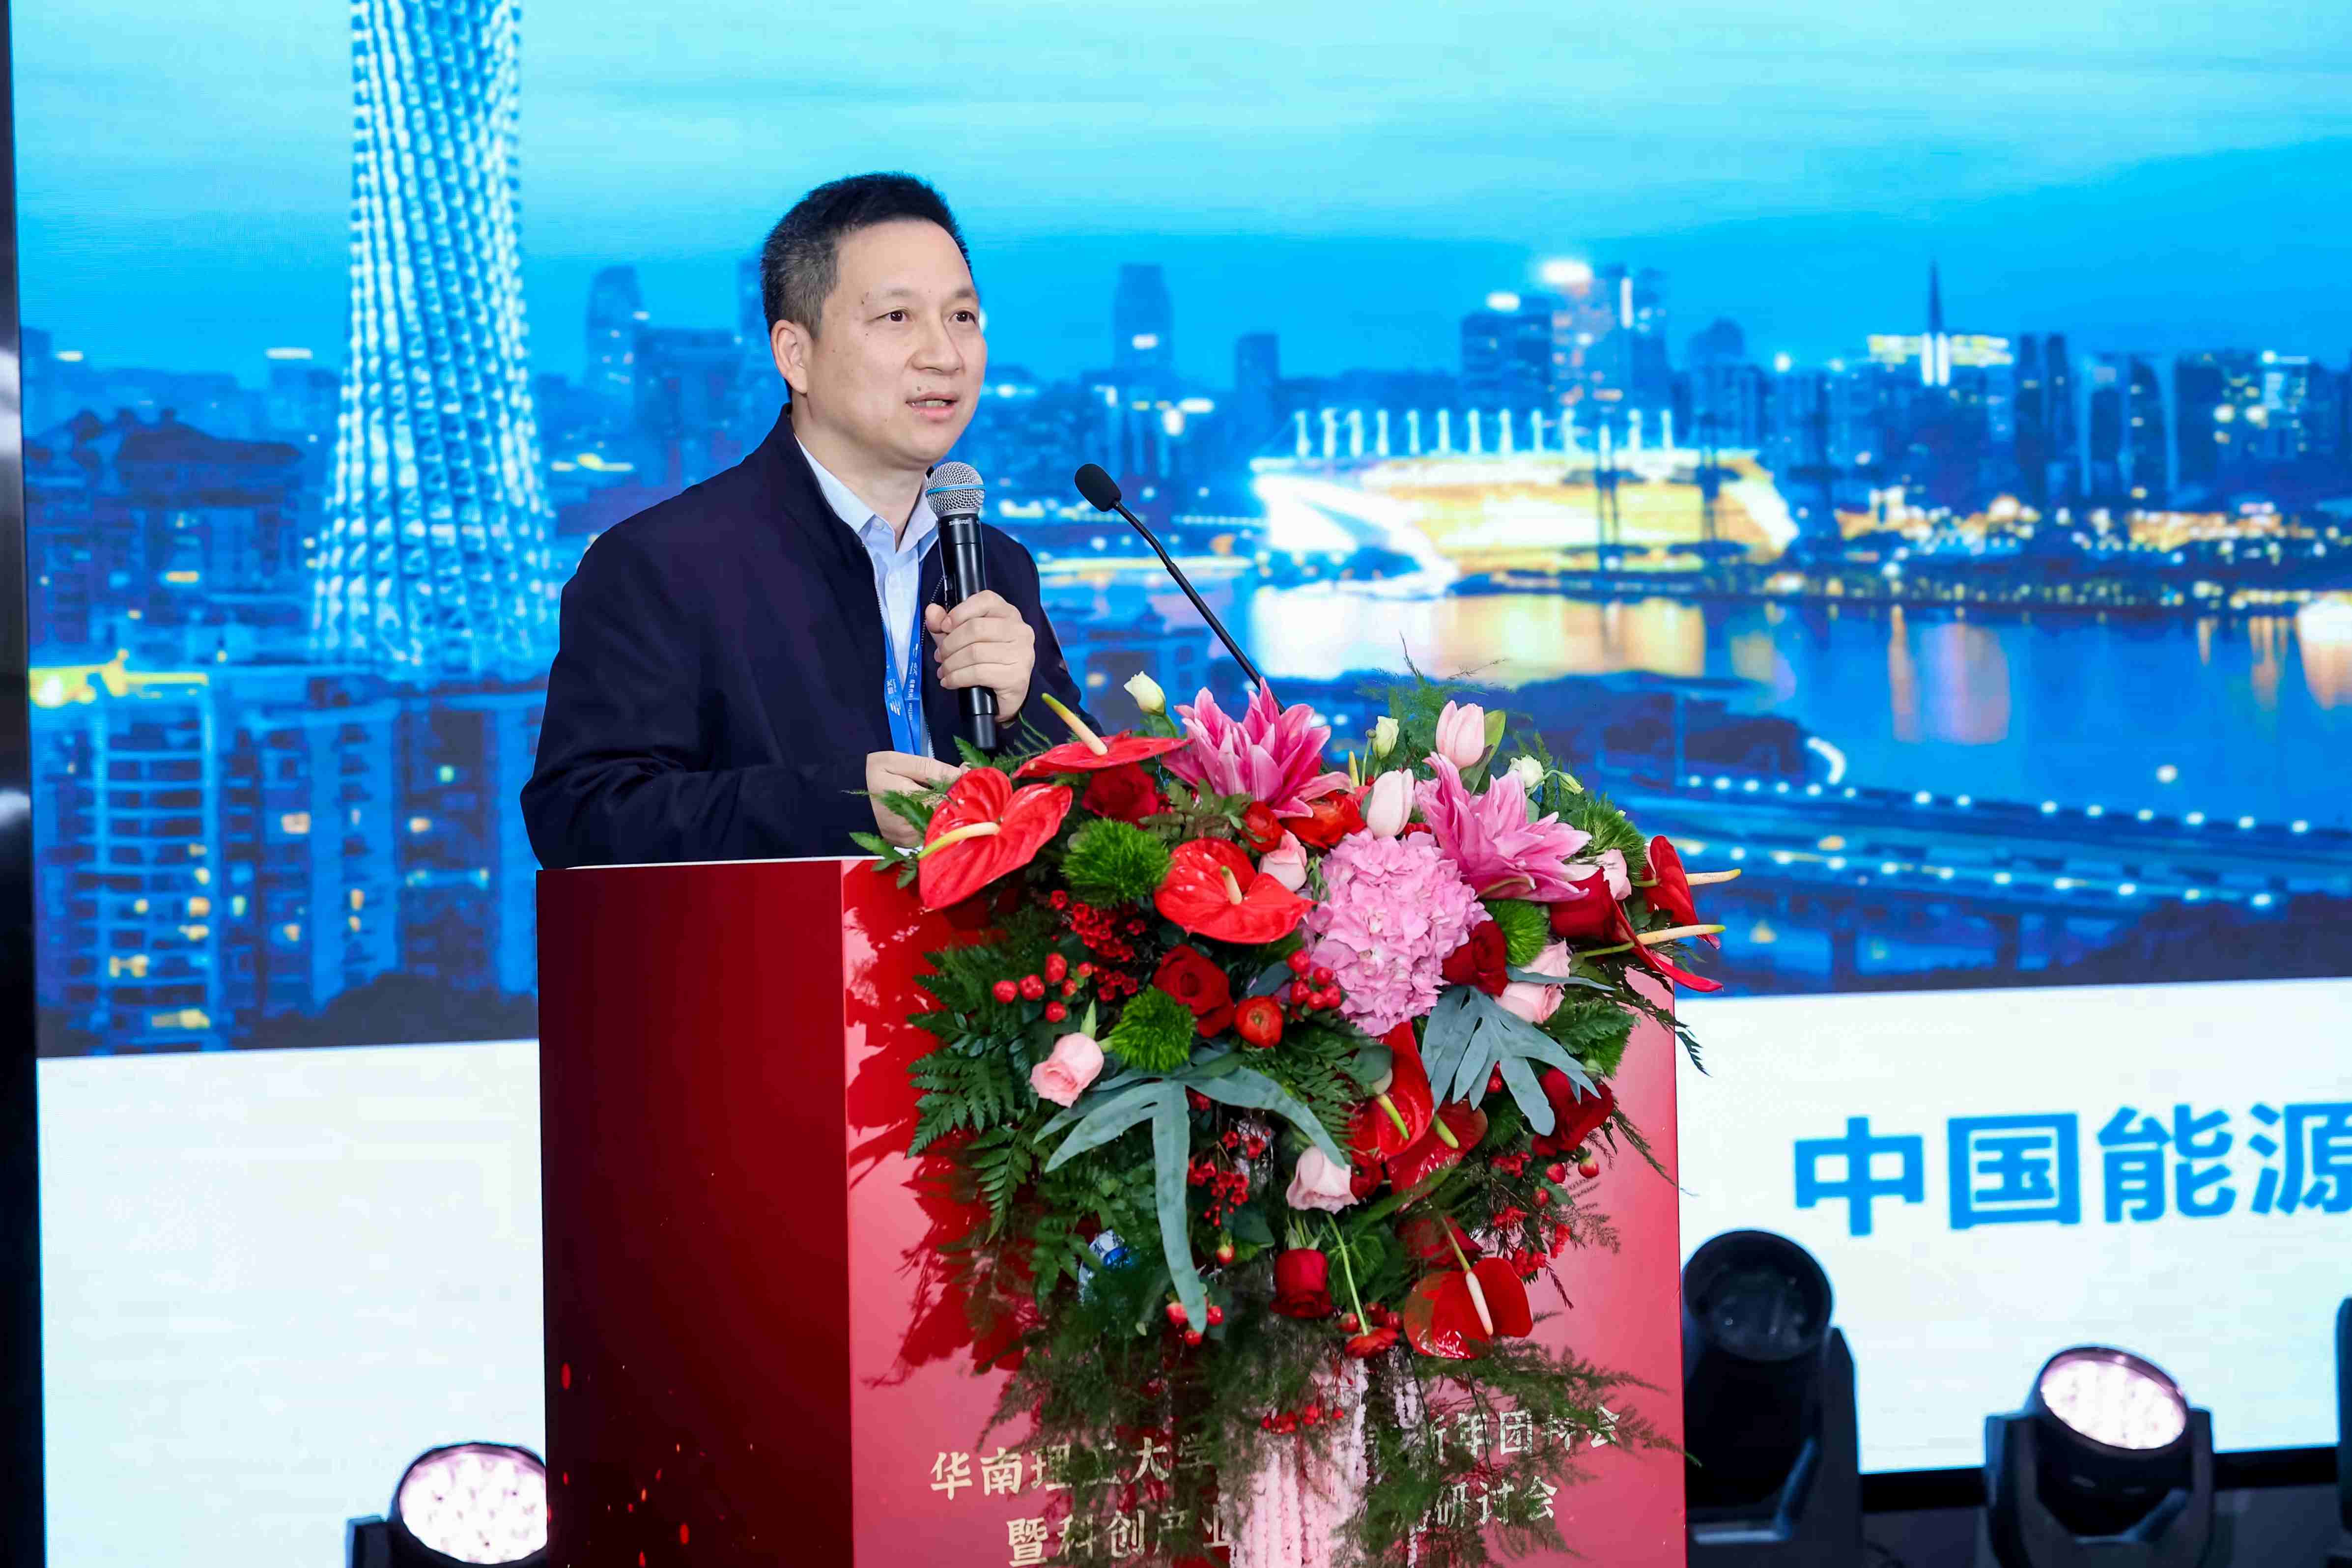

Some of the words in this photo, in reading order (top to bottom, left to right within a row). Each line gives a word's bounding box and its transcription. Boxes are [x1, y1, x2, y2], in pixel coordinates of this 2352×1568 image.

[1793, 1102, 2352, 1237] 中国能源
[1416, 1476, 1559, 1532] 研讨会
